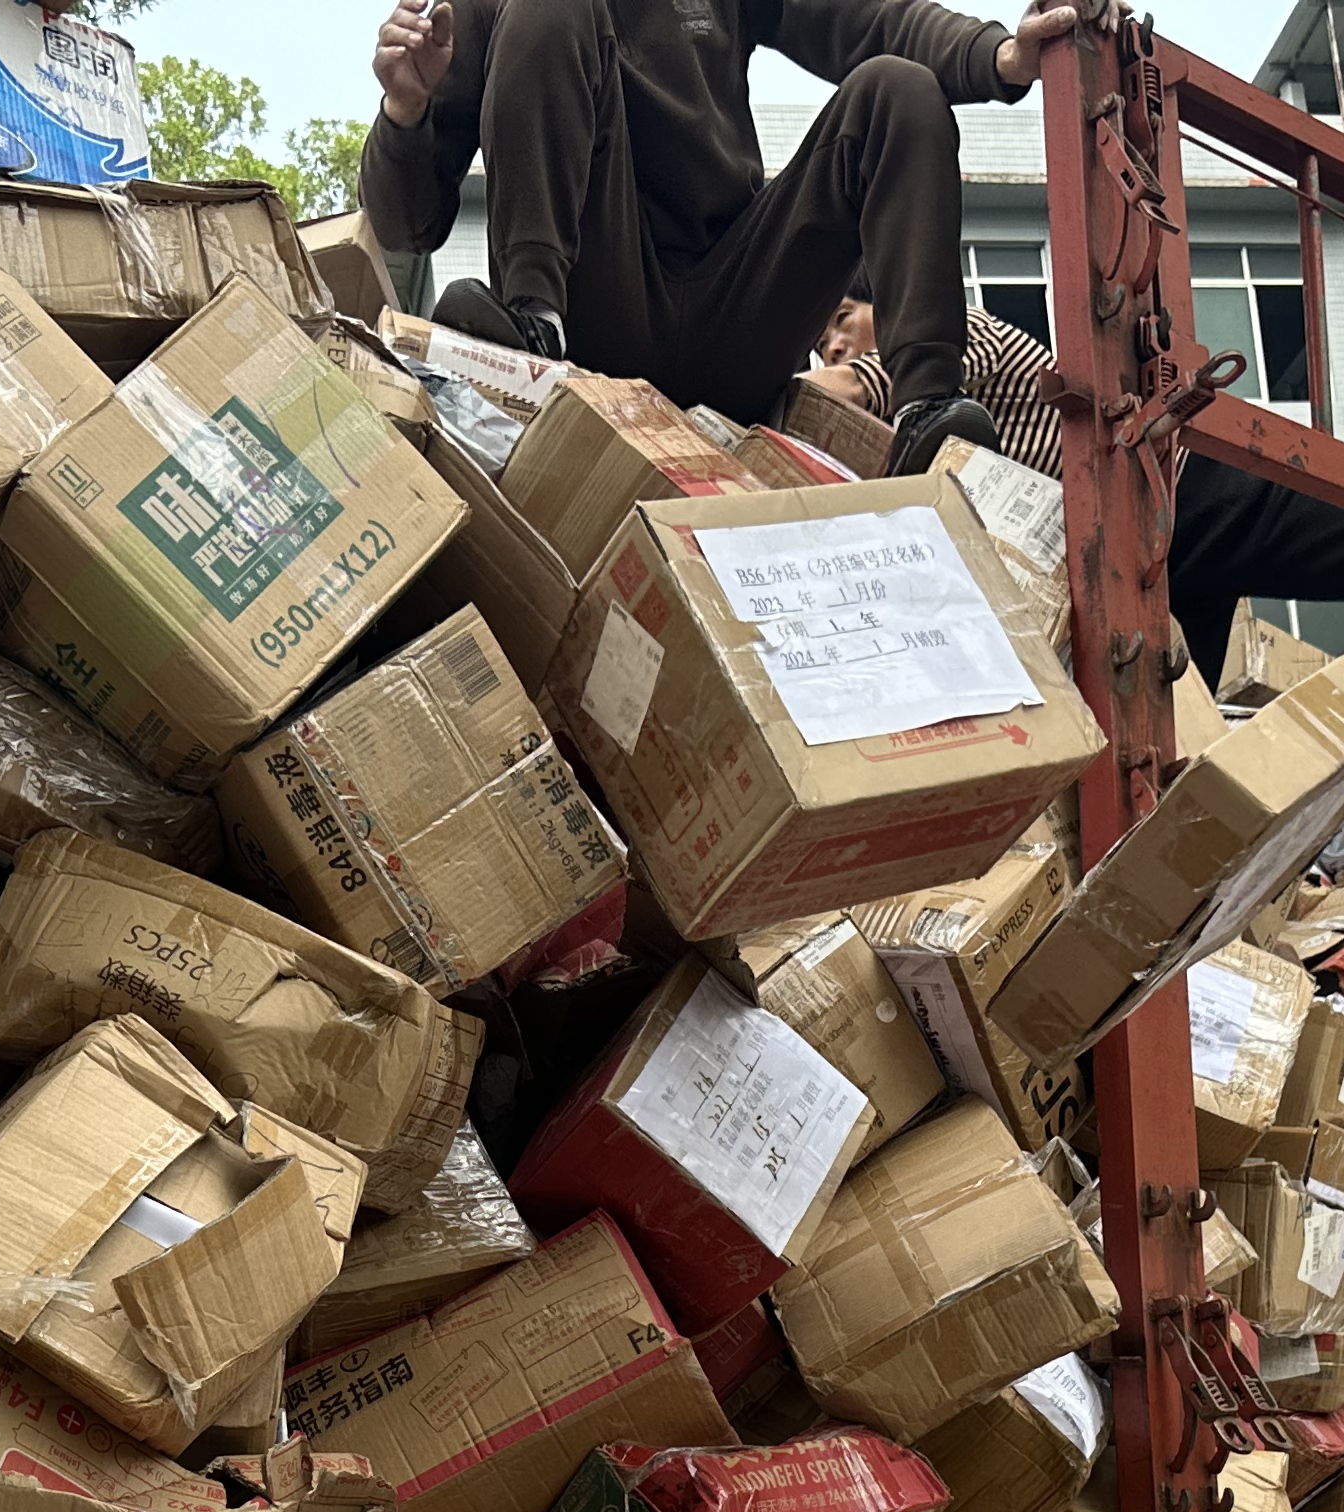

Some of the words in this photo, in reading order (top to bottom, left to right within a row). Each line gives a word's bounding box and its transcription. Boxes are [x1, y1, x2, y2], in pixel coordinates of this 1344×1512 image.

[749, 595, 786, 615] 2023
[798, 589, 817, 609] 年
[781, 648, 817, 670] 2024
[824, 645, 843, 664] 年
[1045, 866, 1065, 898] F3
[990, 896, 1035, 952] EXPRESS
[122, 924, 215, 982] 25PCS
[96, 956, 187, 1023] 装箱数
[625, 1321, 667, 1356] F4
[7, 1383, 47, 1423] F4
[731, 1461, 807, 1494] NONGFU
